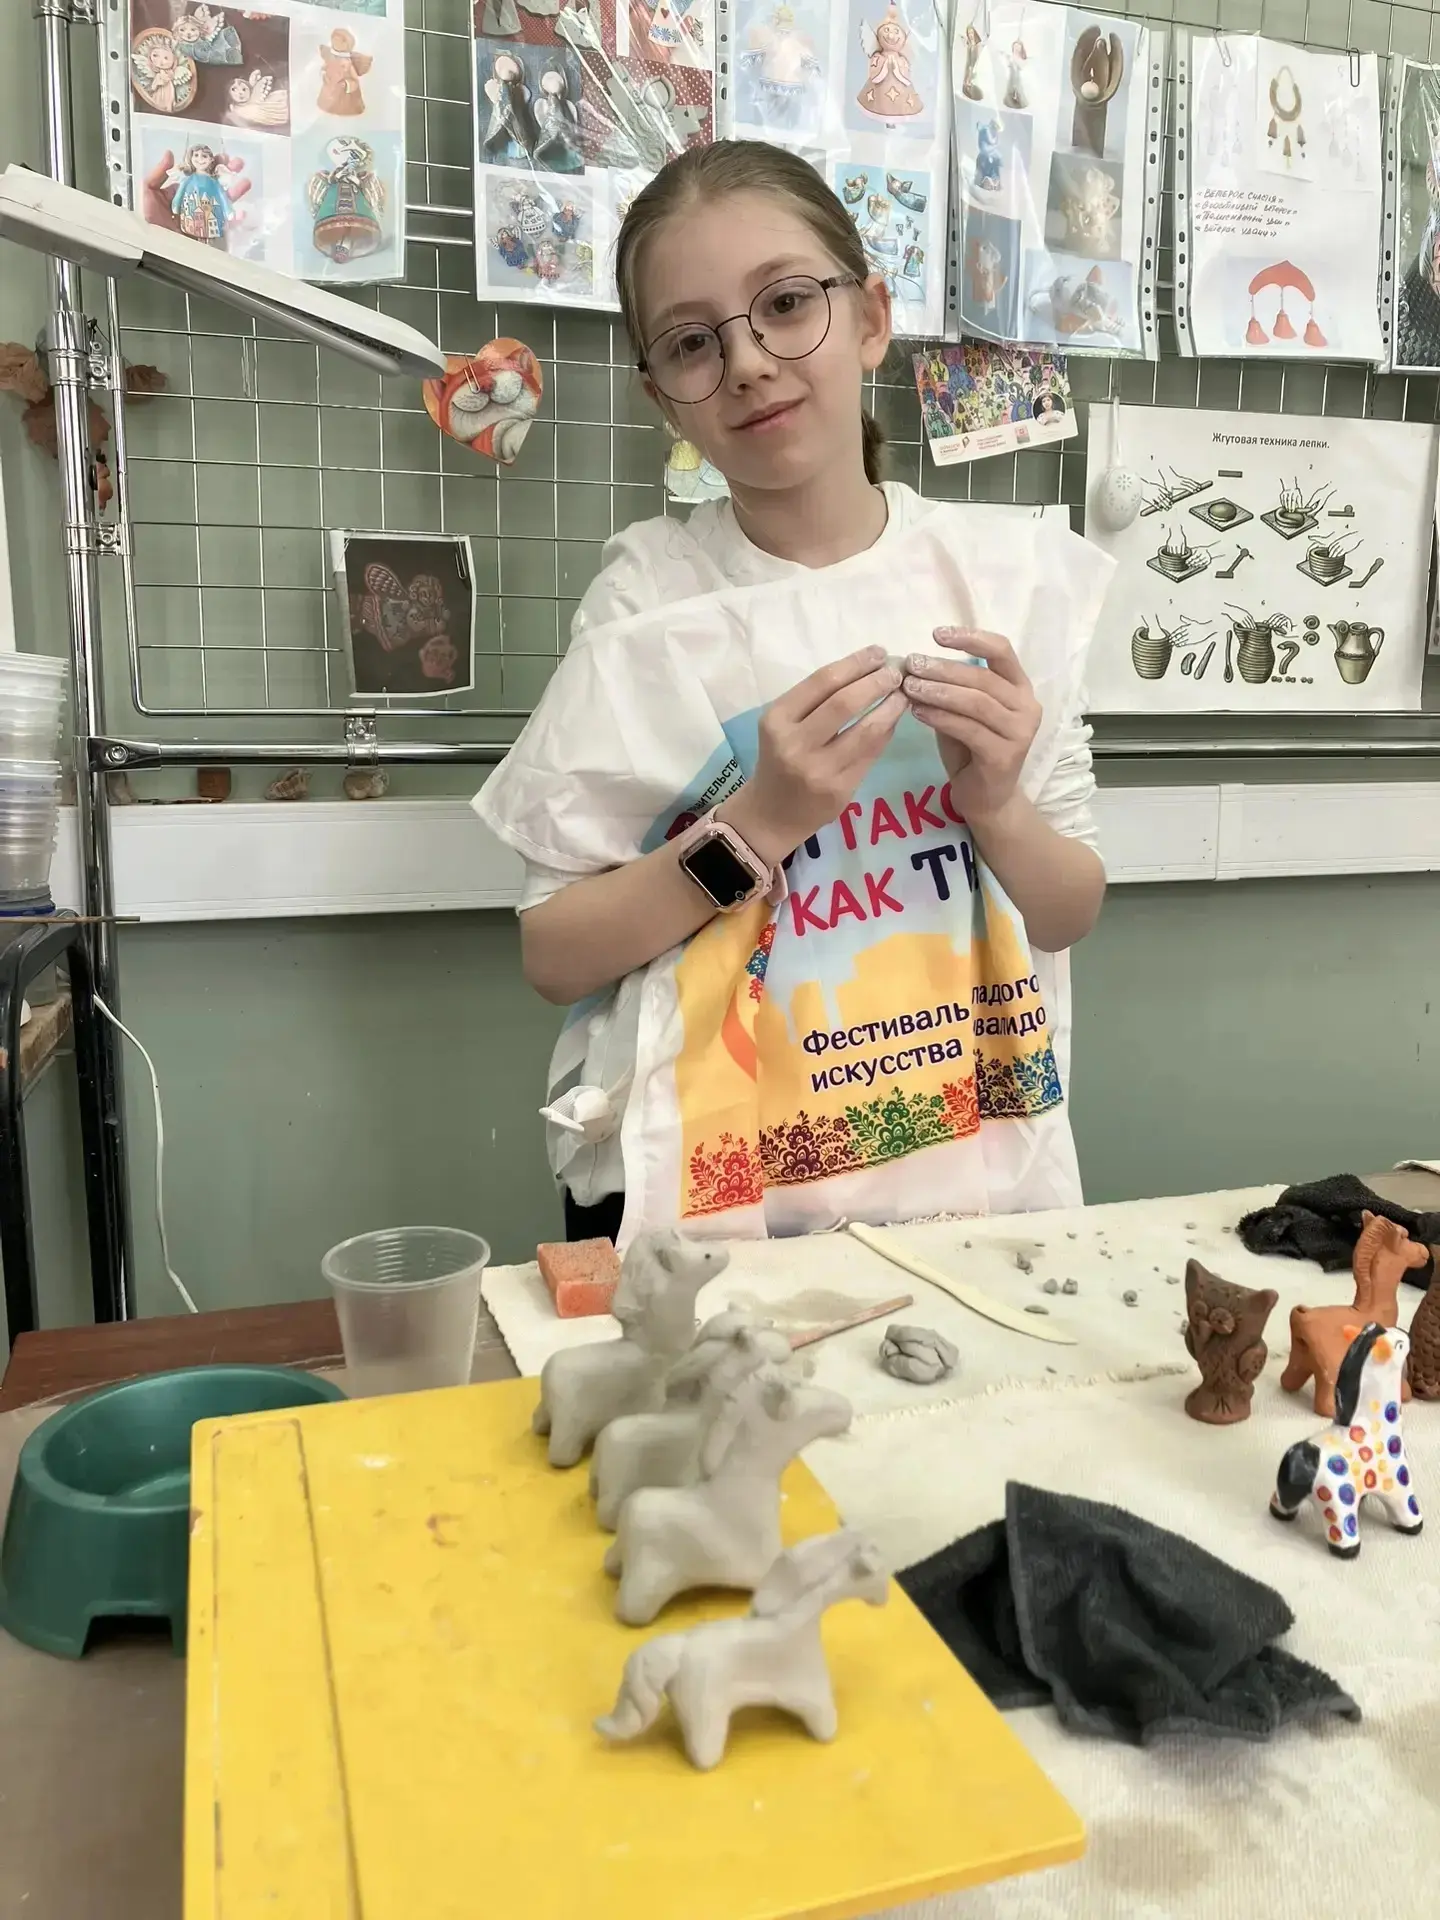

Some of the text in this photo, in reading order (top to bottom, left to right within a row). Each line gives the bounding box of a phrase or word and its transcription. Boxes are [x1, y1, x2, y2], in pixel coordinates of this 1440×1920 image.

[1212, 432, 1330, 449] Жгутовая техника лепки.
[790, 867, 905, 937] КАК
[802, 1001, 971, 1056] Фестиваль
[811, 1006, 1046, 1093] искусства валидо
